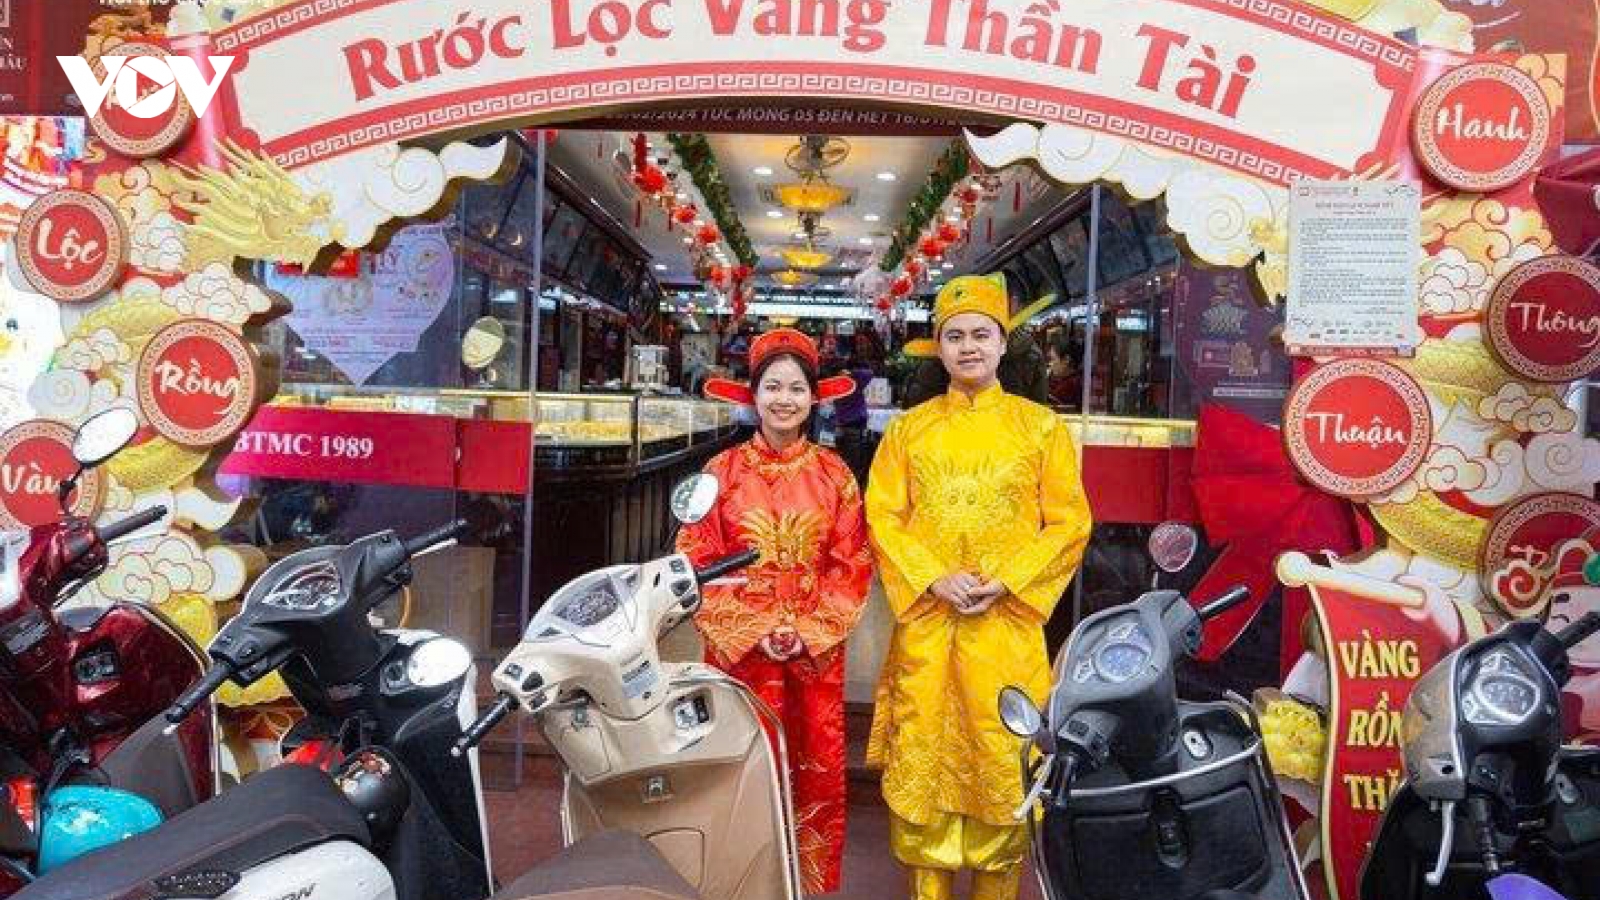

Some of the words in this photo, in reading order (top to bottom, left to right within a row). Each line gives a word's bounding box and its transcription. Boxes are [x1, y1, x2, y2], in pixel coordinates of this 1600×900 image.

[342, 12, 527, 101] Rước
[1136, 22, 1257, 119] Tài
[37, 217, 103, 270] Lộc
[1510, 302, 1600, 347] Thông
[155, 358, 240, 414] Rồng
[319, 435, 374, 459] 1989
[1306, 415, 1407, 449] Thuận
[1338, 629, 1419, 679] VÀNG
[1346, 691, 1403, 747] RỒN
